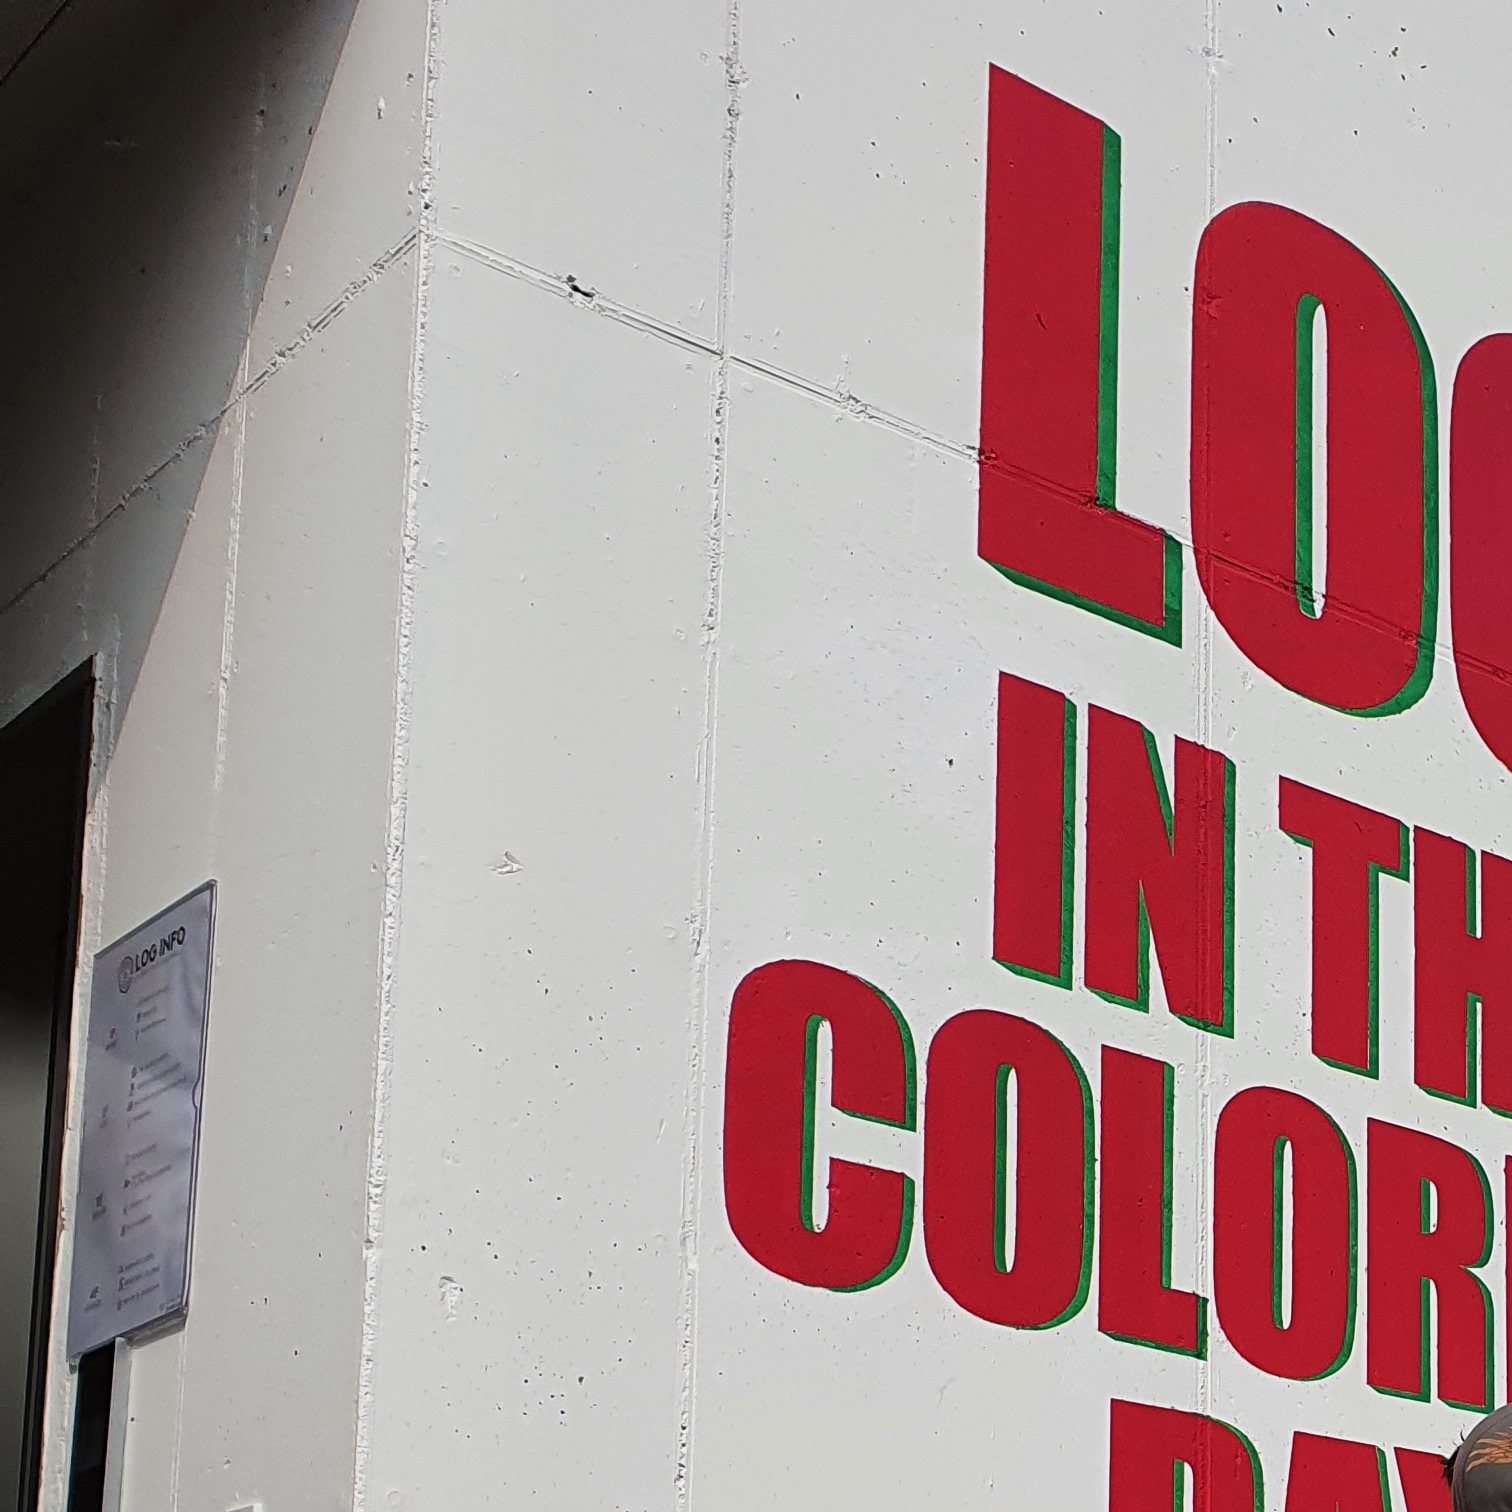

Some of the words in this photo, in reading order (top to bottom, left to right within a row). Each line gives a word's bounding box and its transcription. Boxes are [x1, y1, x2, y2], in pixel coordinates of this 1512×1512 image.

[135, 943, 158, 972] LOG
[159, 925, 186, 957] INFO
[993, 673, 1235, 1038] IN
